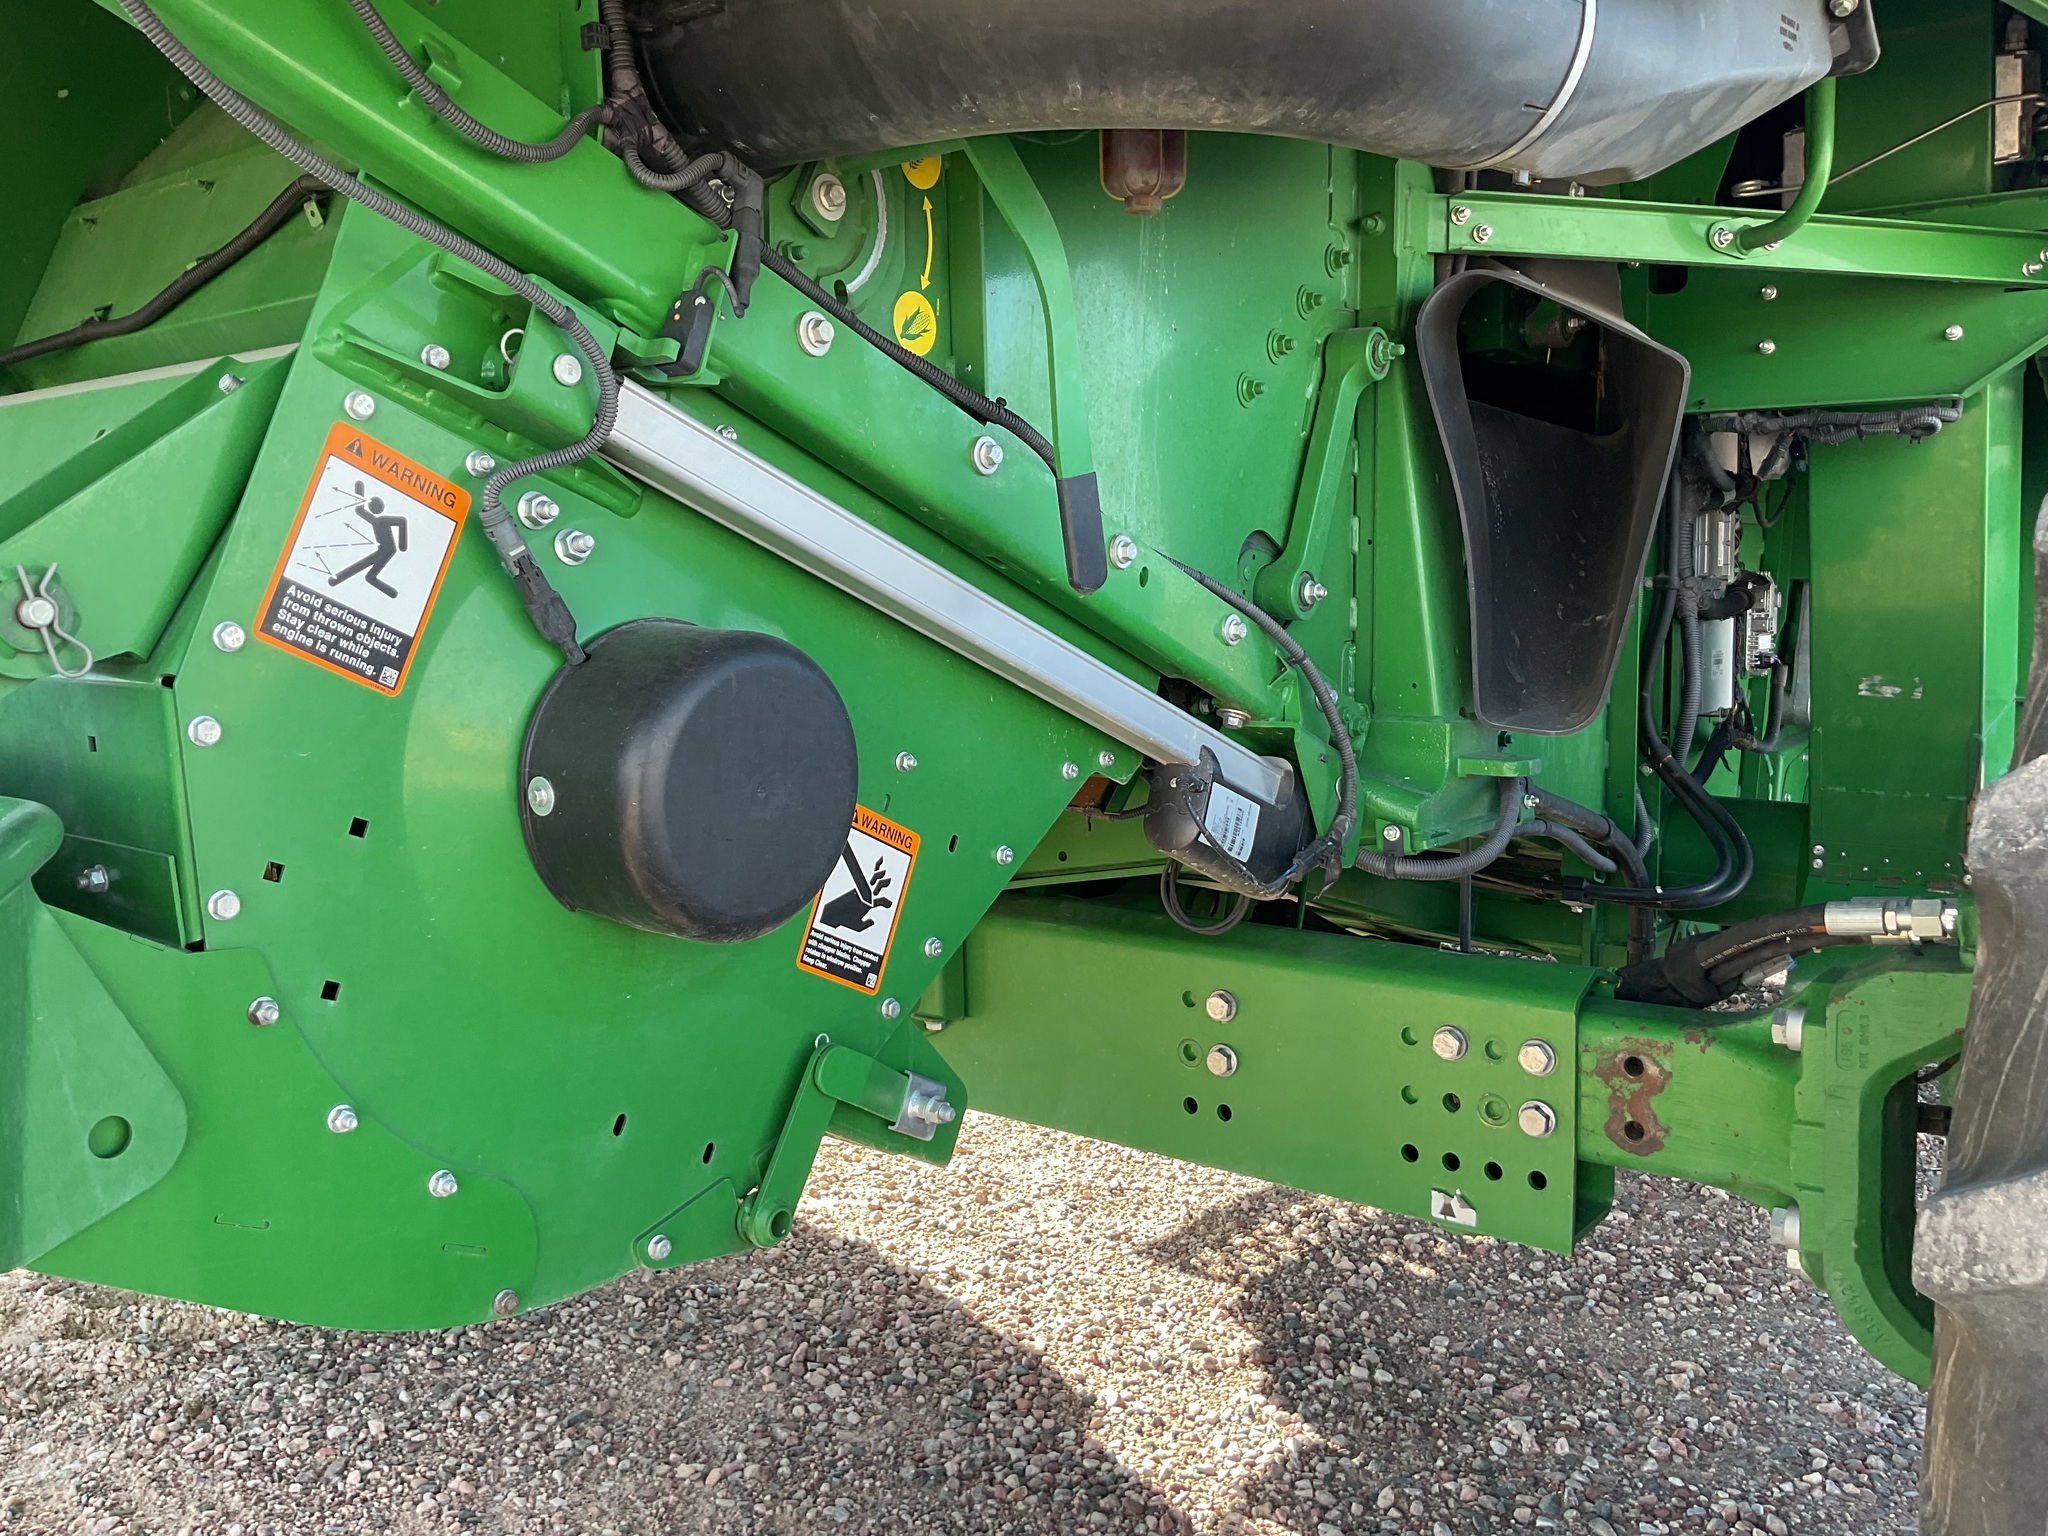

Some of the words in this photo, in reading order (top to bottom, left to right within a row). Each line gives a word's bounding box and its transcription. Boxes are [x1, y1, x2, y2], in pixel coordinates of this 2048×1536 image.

[372, 450, 456, 508] WARNING
[278, 608, 305, 630] Stay
[307, 624, 337, 642] clear
[340, 638, 369, 658] while
[282, 596, 311, 617] from
[313, 611, 354, 636] thrown
[356, 631, 399, 658] objects.
[287, 584, 323, 608] Avoid
[324, 603, 368, 629] serious
[370, 622, 402, 647] injury
[272, 622, 314, 646] engine
[315, 640, 327, 653] is
[330, 648, 376, 676] running.
[862, 814, 912, 849] WARNING
[803, 954, 814, 965] Keep
[815, 959, 827, 969] Clear.
[805, 947, 821, 957] rotates
[826, 955, 844, 966] windrow
[844, 963, 862, 973] position.
[810, 930, 824, 939] Avoid
[824, 935, 840, 946] serious
[840, 941, 852, 952] injury
[853, 947, 863, 955] from
[863, 952, 879, 962] contact
[818, 942, 836, 954] chopper
[836, 949, 851, 960] blades.
[853, 956, 871, 968] Chopper
